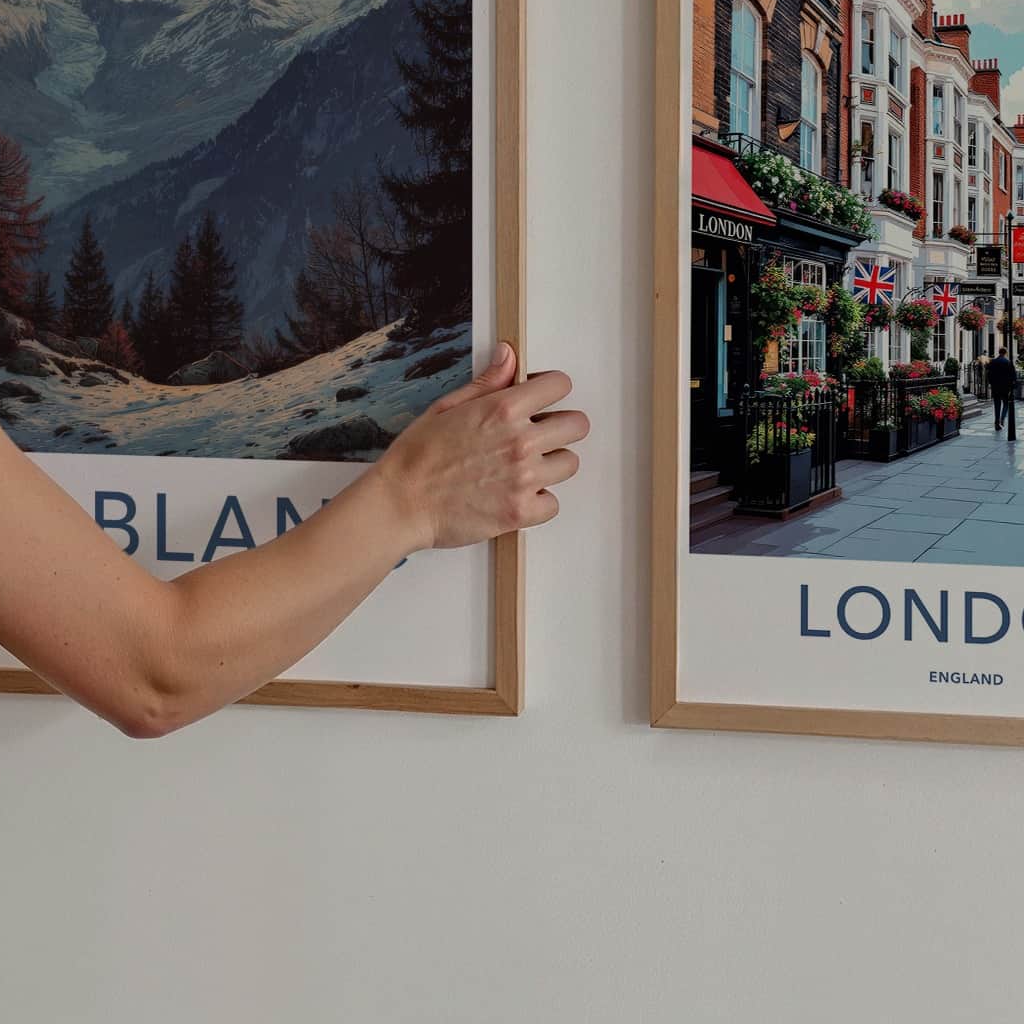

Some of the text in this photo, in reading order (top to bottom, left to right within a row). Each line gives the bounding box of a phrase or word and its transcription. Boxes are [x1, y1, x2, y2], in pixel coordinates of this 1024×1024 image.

[698, 213, 753, 241] LONDON
[801, 585, 1024, 645] LOND
[929, 671, 1004, 686] ENGLAND
